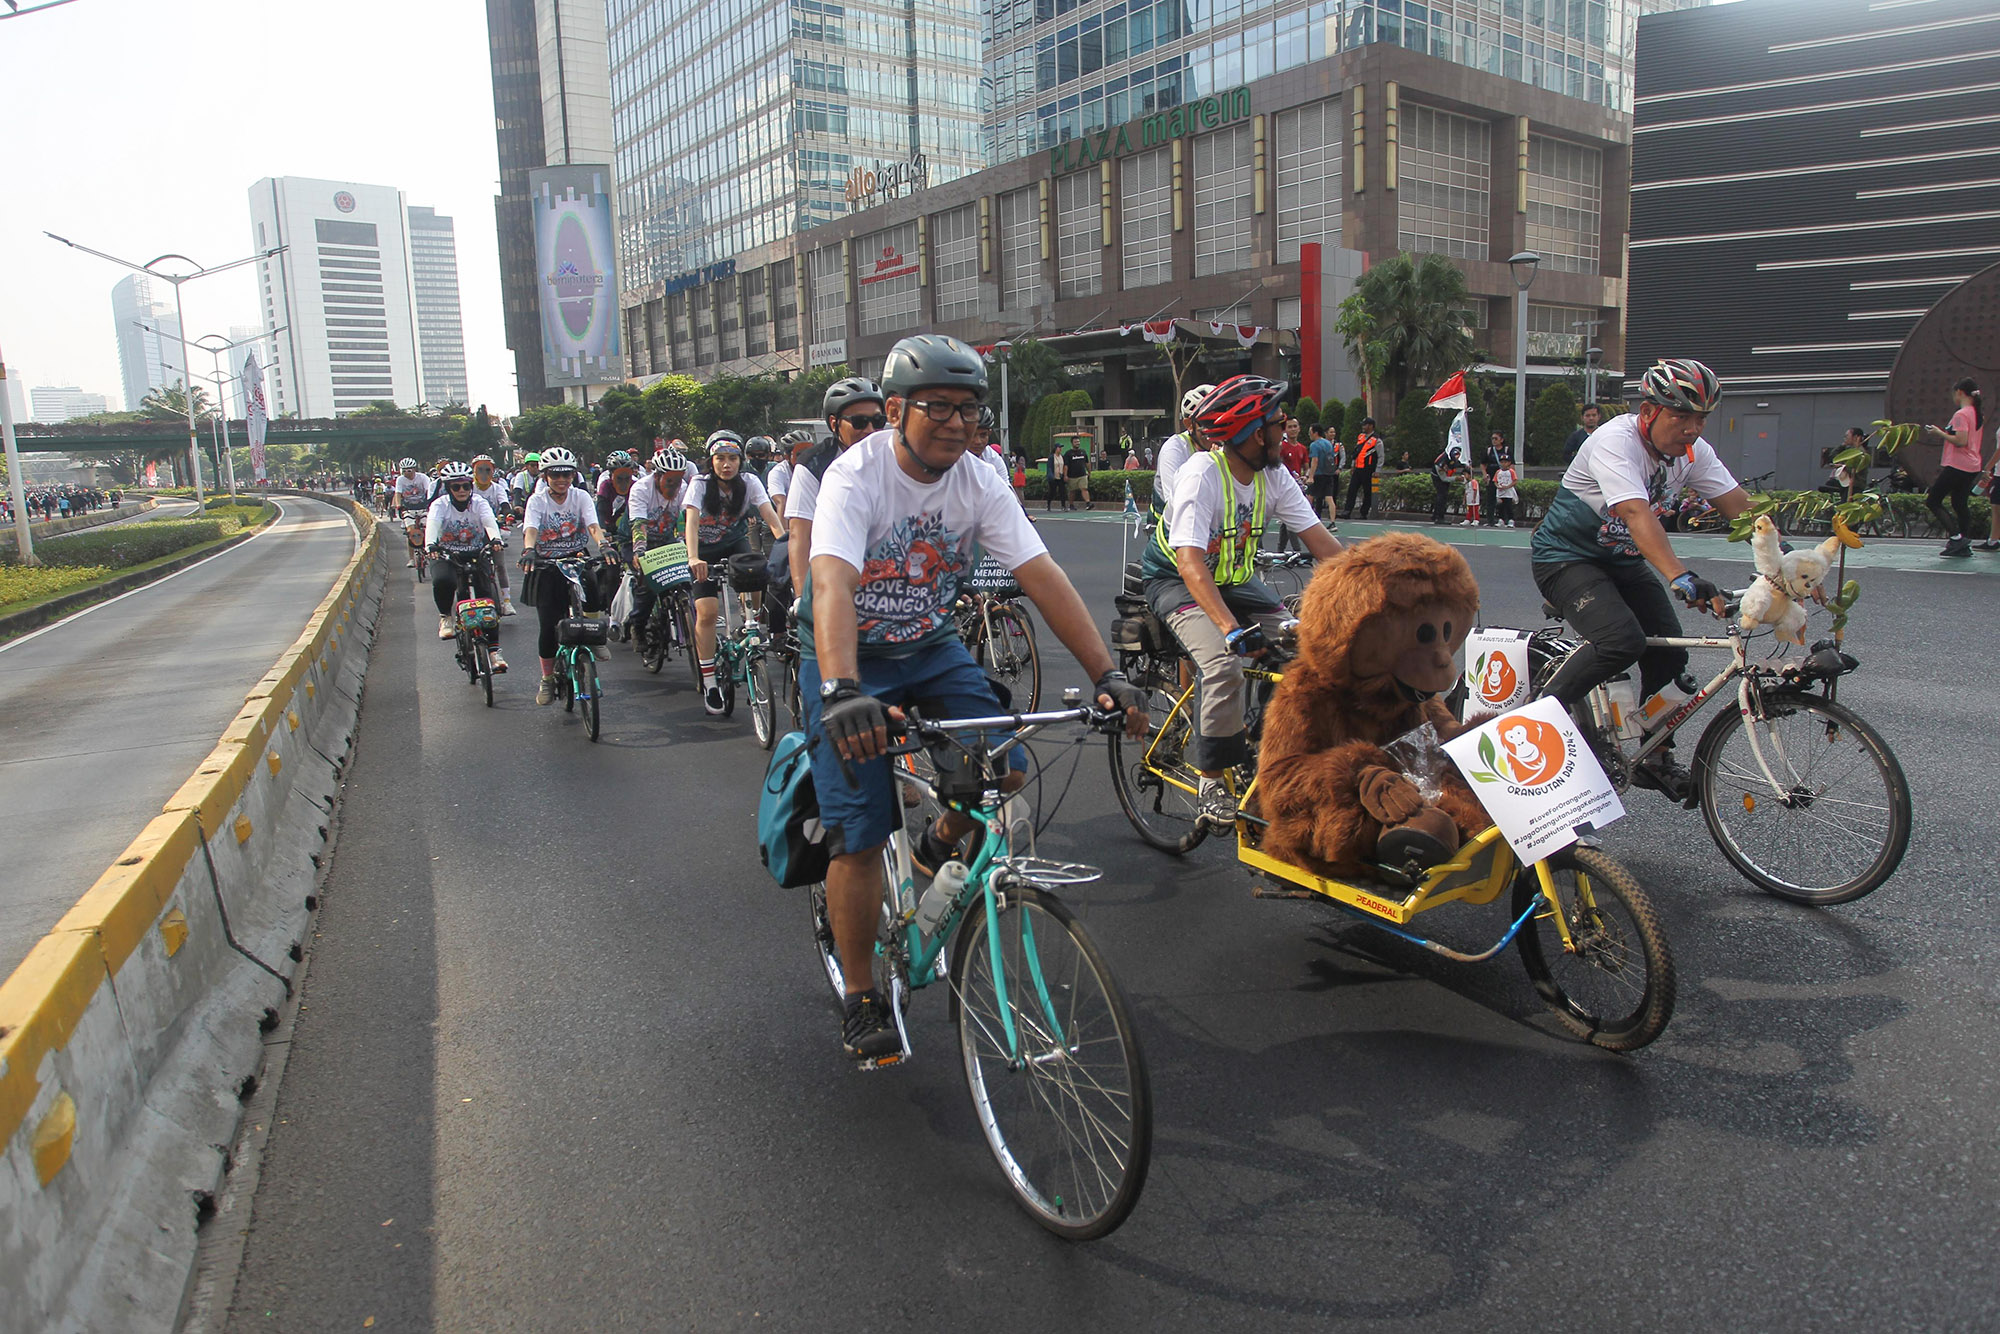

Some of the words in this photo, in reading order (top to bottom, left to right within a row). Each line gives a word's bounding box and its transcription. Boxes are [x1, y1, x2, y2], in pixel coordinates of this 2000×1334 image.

[1051, 126, 1133, 174] PLAZA
[1142, 86, 1250, 147] marein
[865, 579, 905, 594] LOVE
[906, 585, 928, 598] FOR
[971, 578, 1018, 587] ORANGUTA
[1475, 691, 1503, 710] ORANGUTAN
[1504, 698, 1515, 708] DAY
[1513, 686, 1524, 699] 2024
[1666, 689, 1708, 730] NISHIKI
[1567, 738, 1577, 758] 2024
[1562, 759, 1576, 778] DAY
[1507, 776, 1566, 797] ORANGUTAN
[1513, 788, 1613, 846] #JagaOrangutanJagaKehidupan
[1529, 788, 1592, 826] #LoveForOrangutan
[1526, 800, 1613, 850] #JagaHutanJagaOrangutan
